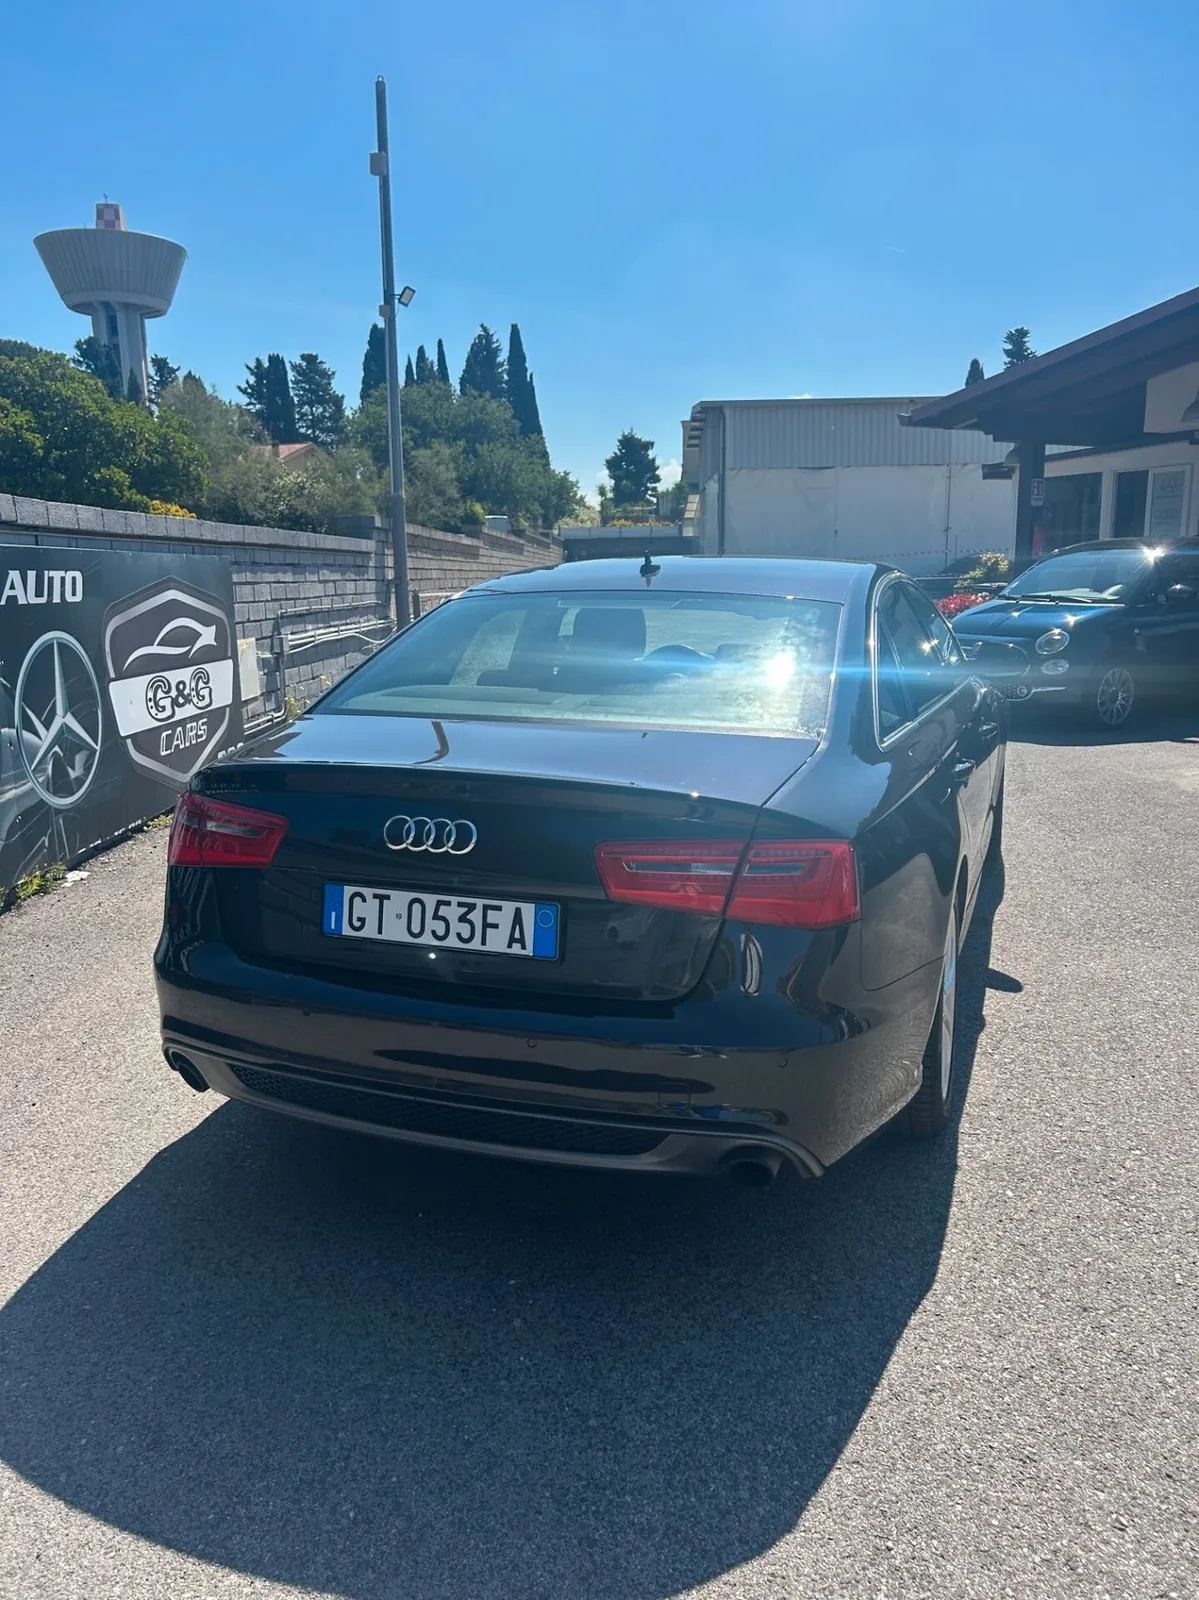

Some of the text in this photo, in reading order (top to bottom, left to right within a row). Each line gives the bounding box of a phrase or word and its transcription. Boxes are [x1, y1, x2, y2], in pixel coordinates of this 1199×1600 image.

[0, 570, 83, 605] AUTO
[145, 667, 213, 722] G&G
[160, 718, 208, 756] CARS
[347, 891, 391, 935] GT
[406, 897, 527, 951] 053FA
